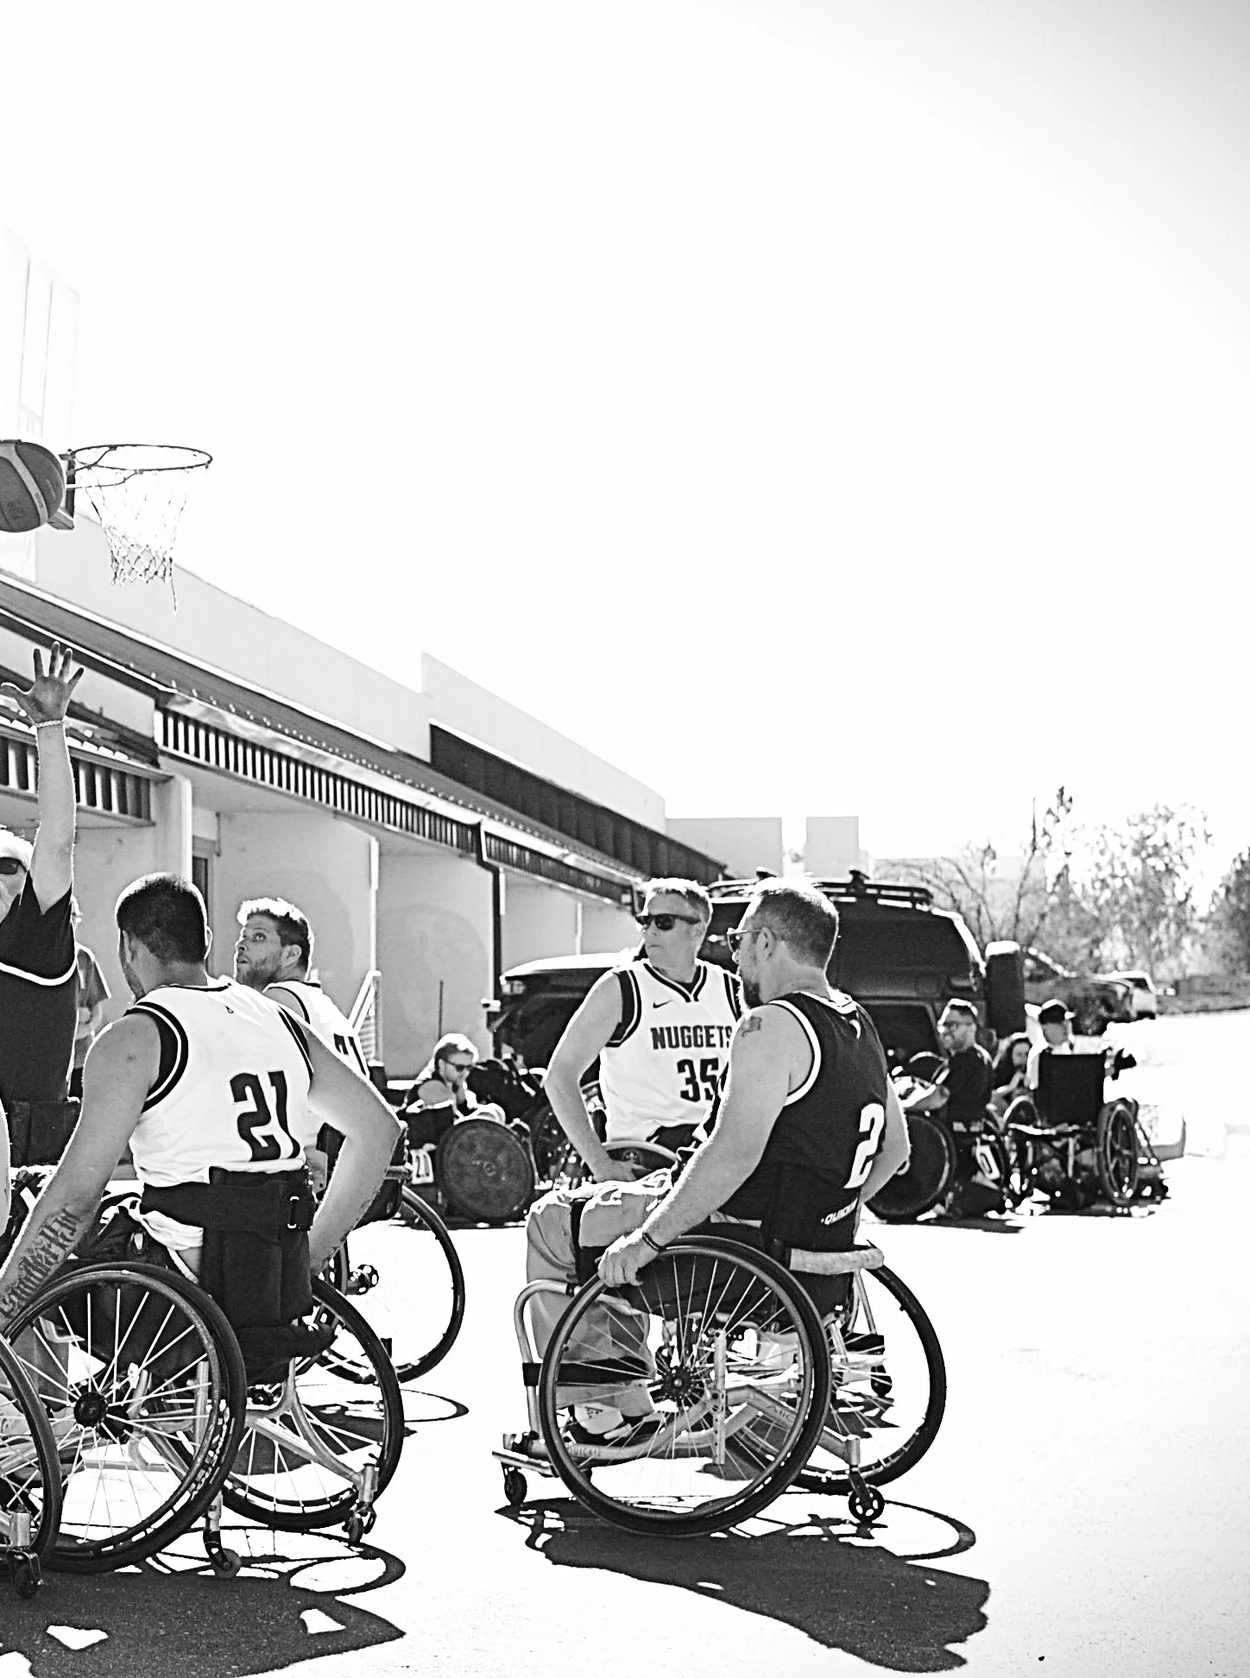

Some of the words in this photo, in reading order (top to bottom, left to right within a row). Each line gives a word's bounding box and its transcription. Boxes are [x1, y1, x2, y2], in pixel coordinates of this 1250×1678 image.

[229, 1070, 301, 1161] 21
[676, 1057, 719, 1103] 35
[843, 1102, 885, 1189] 2
